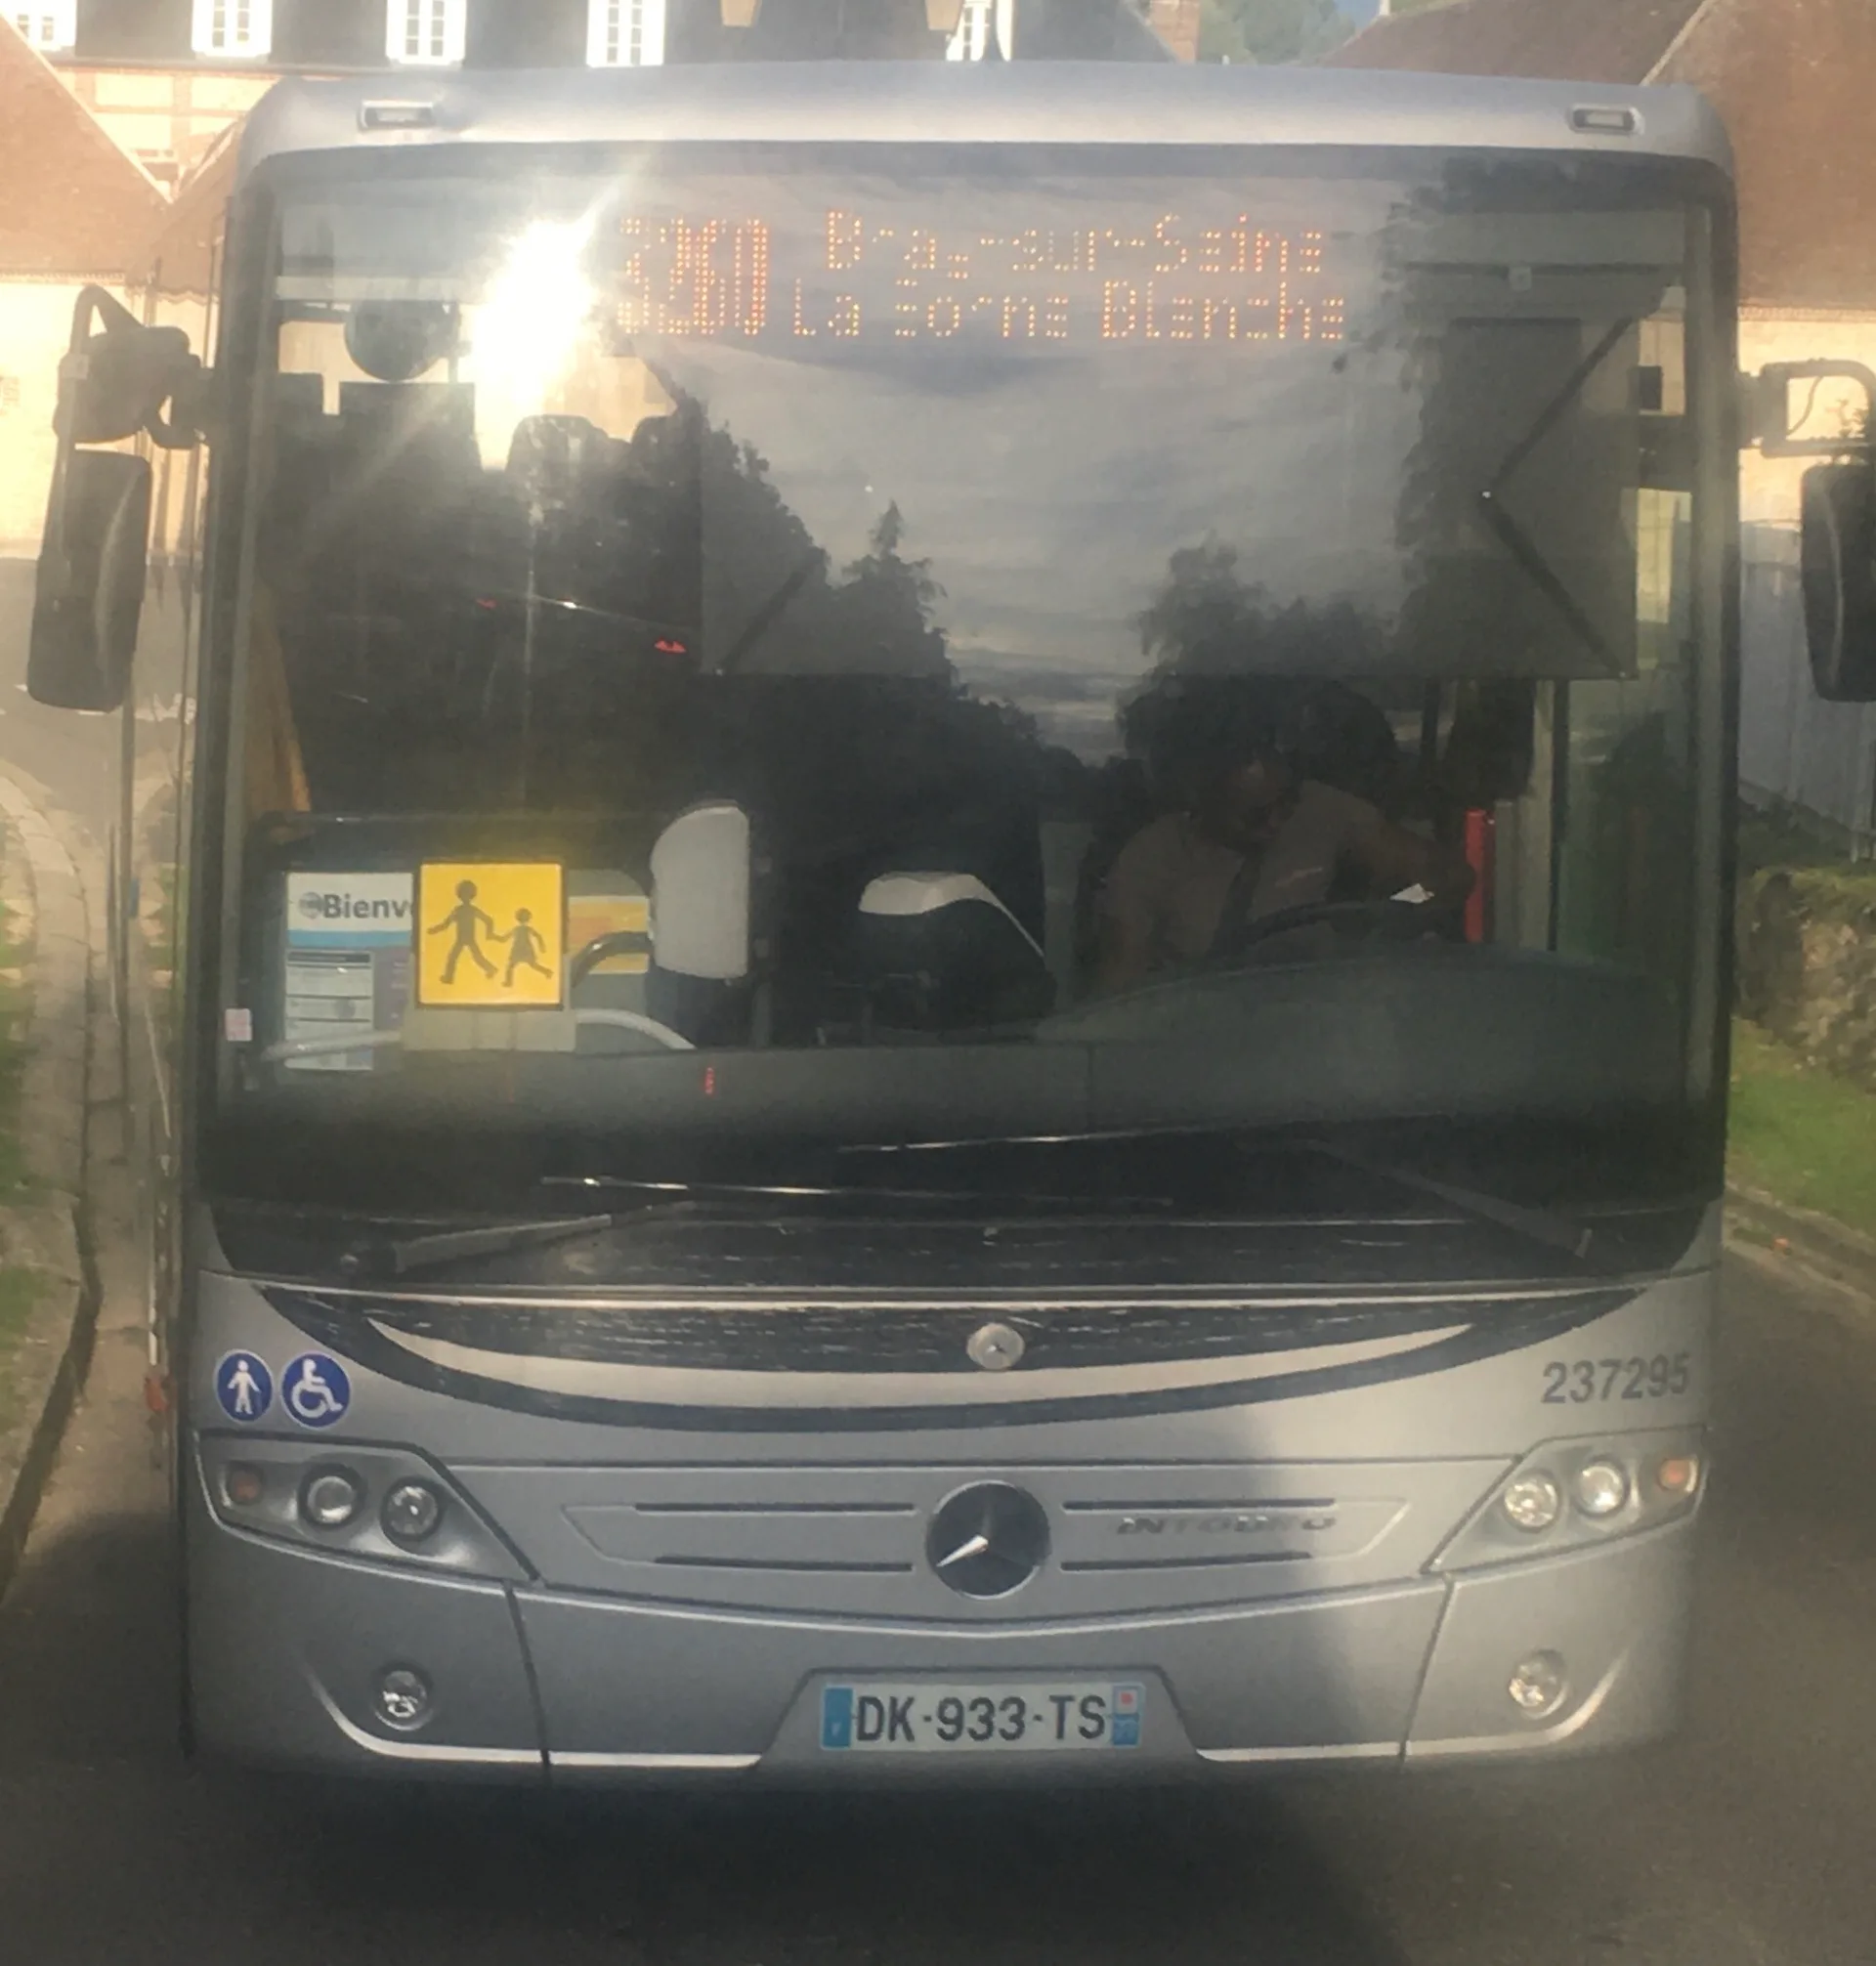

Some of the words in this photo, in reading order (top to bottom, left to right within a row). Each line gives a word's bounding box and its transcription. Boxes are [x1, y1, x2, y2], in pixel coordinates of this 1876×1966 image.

[792, 277, 860, 336] La
[323, 892, 413, 919] Bienv
[1541, 1351, 1691, 1404] 237295
[855, 1694, 1107, 1742] DK-933-TS
